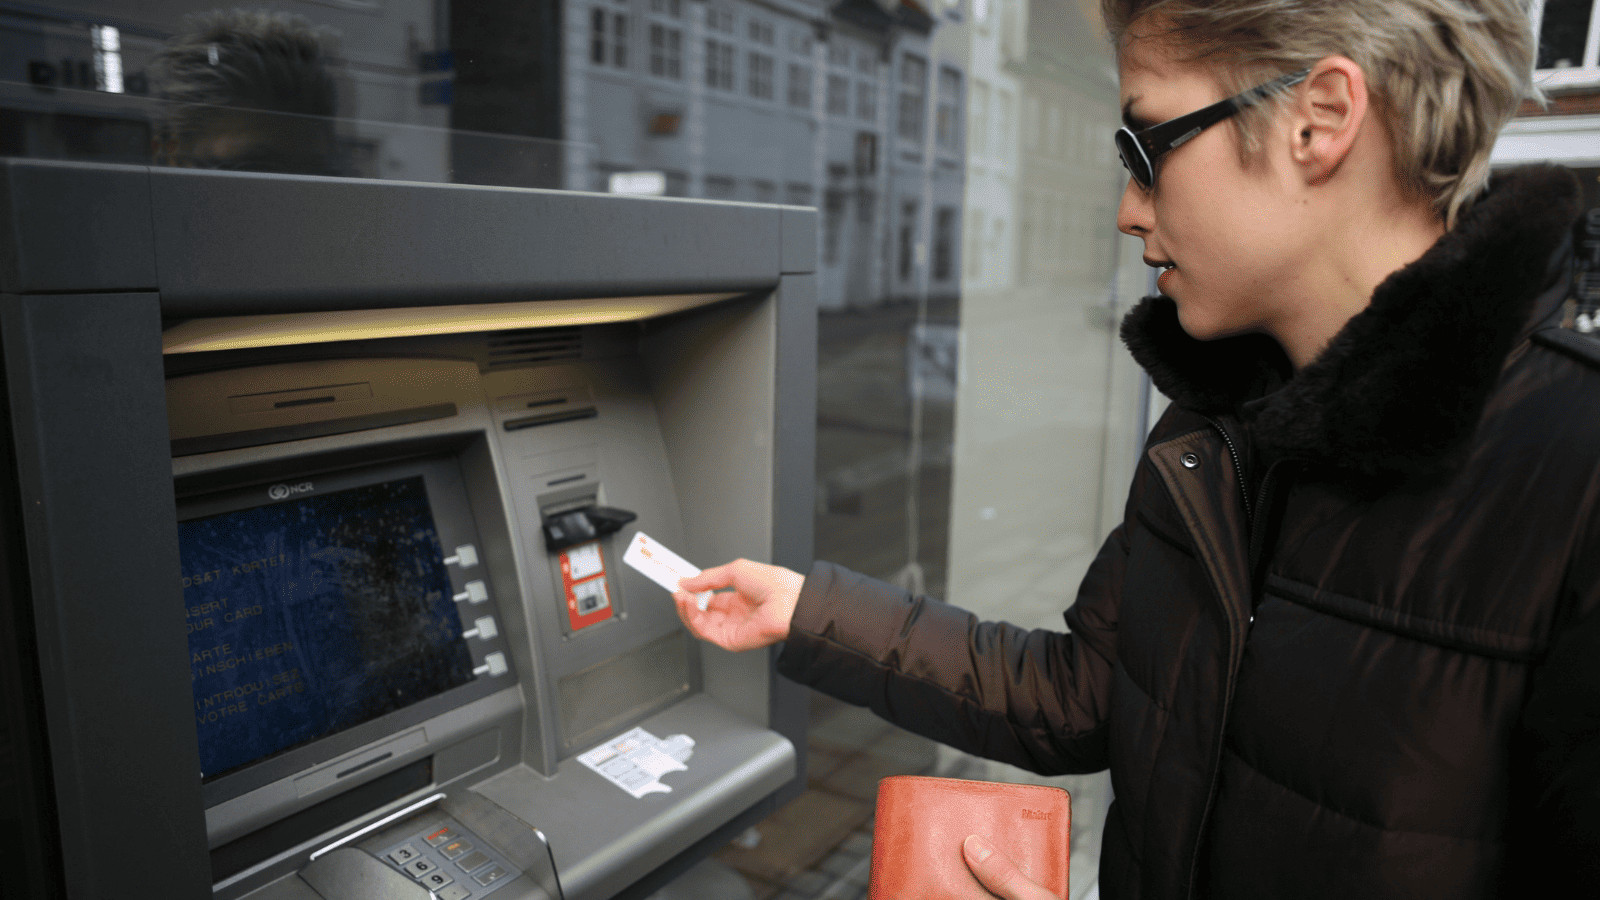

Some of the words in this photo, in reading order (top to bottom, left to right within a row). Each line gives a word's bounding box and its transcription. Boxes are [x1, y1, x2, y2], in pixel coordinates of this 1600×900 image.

[289, 481, 314, 494] NCR
[224, 604, 263, 623] CARD
[192, 643, 233, 664] ARTE
[196, 667, 301, 710] INTRODUISEZ
[198, 700, 249, 725] VOTRE
[257, 681, 305, 706] CARTE
[399, 849, 412, 860] 3
[415, 861, 428, 871] 6
[431, 874, 444, 885] 9
